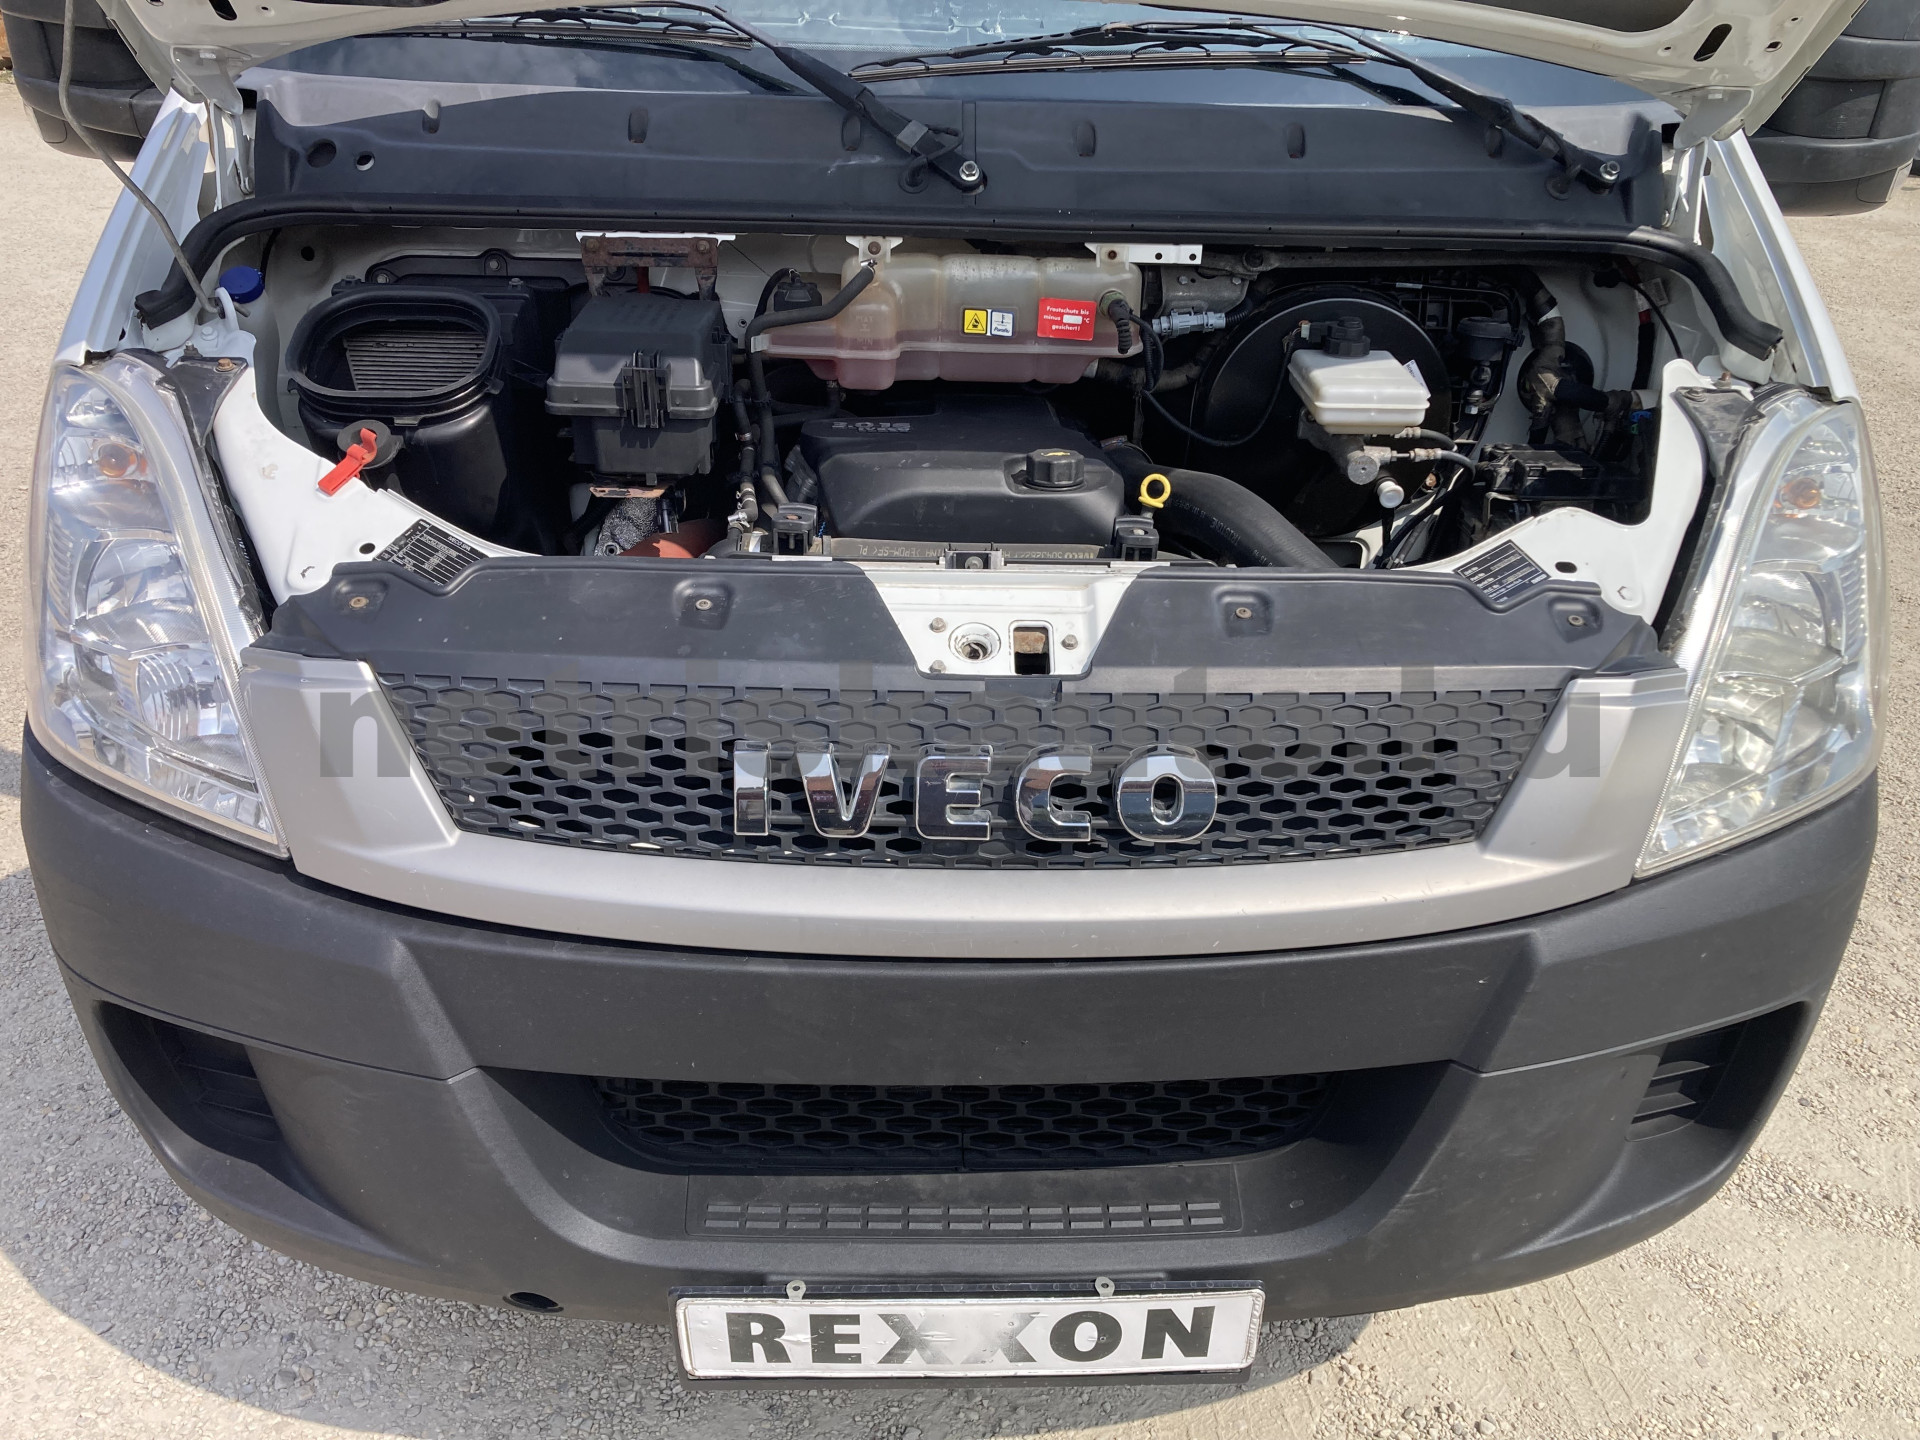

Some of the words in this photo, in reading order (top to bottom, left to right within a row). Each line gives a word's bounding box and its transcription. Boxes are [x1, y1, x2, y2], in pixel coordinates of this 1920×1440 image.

[1046, 305, 1079, 315] Frostschutz
[1080, 308, 1090, 316] bis
[733, 741, 1220, 843] IVECO
[724, 1305, 1216, 1365] REXXON
